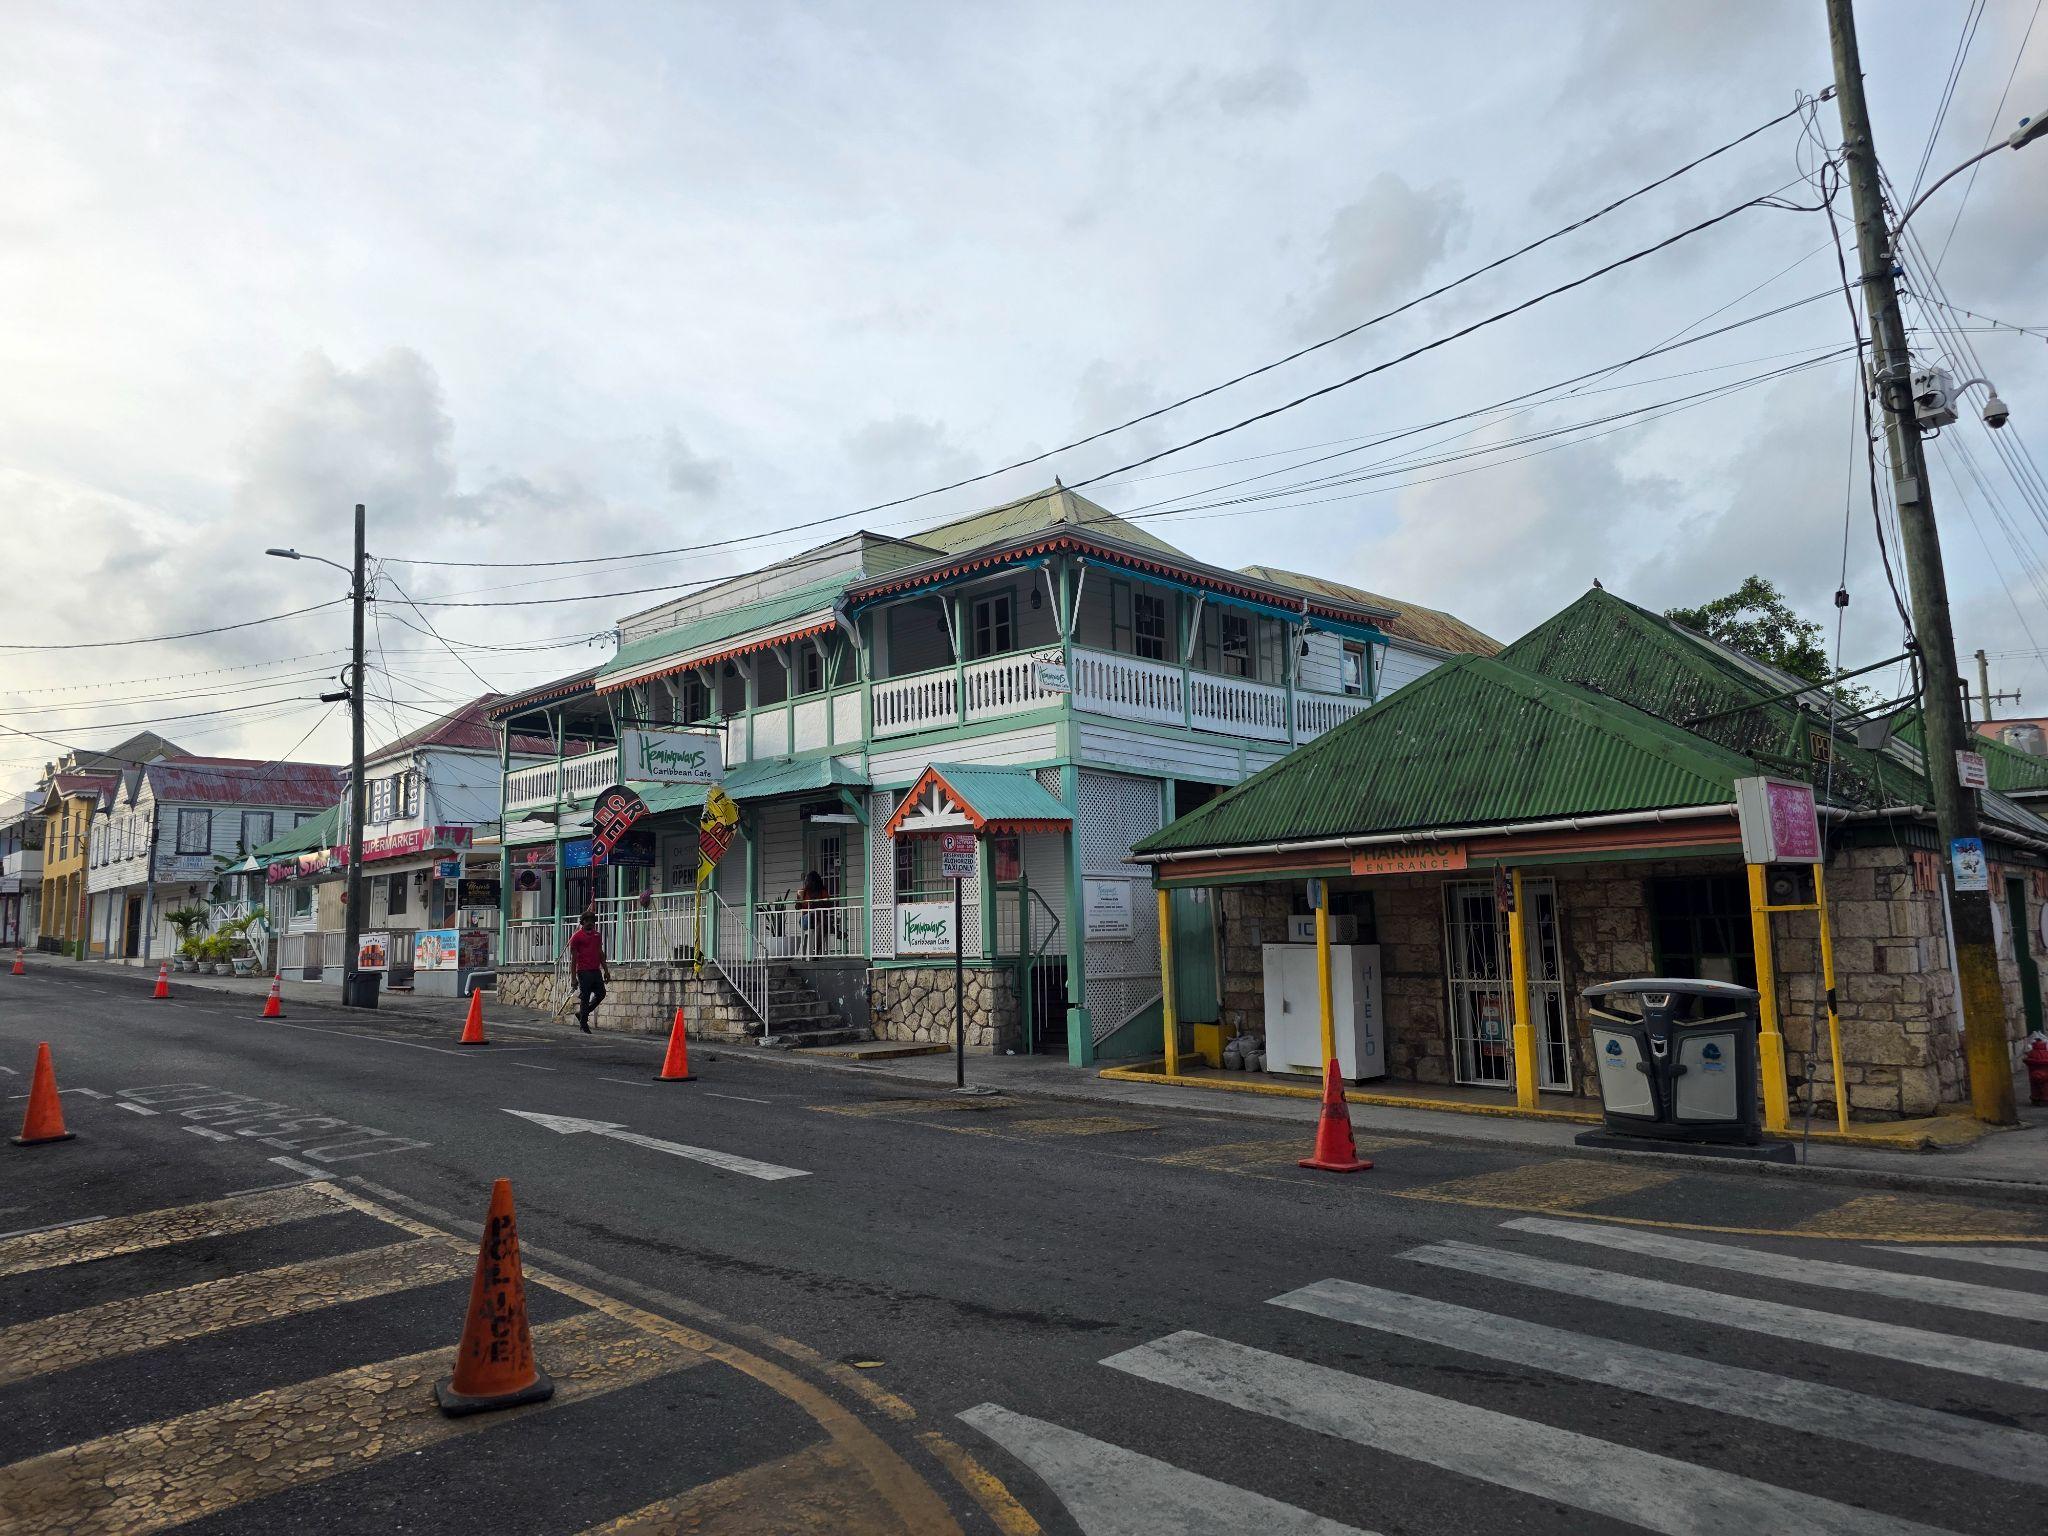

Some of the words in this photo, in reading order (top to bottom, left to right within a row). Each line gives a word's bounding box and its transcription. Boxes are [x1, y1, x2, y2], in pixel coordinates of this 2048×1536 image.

[639, 733, 706, 776] Hemingways
[653, 767, 692, 777] Caribbean
[694, 769, 712, 778] Cafe
[1350, 842, 1462, 862] PHARMACY
[1366, 859, 1450, 873] ENTRANCE
[903, 909, 947, 948] Hemingways
[911, 938, 936, 946] Caribbean
[937, 937, 950, 945] Cafe
[1361, 966, 1375, 1058] HIELO
